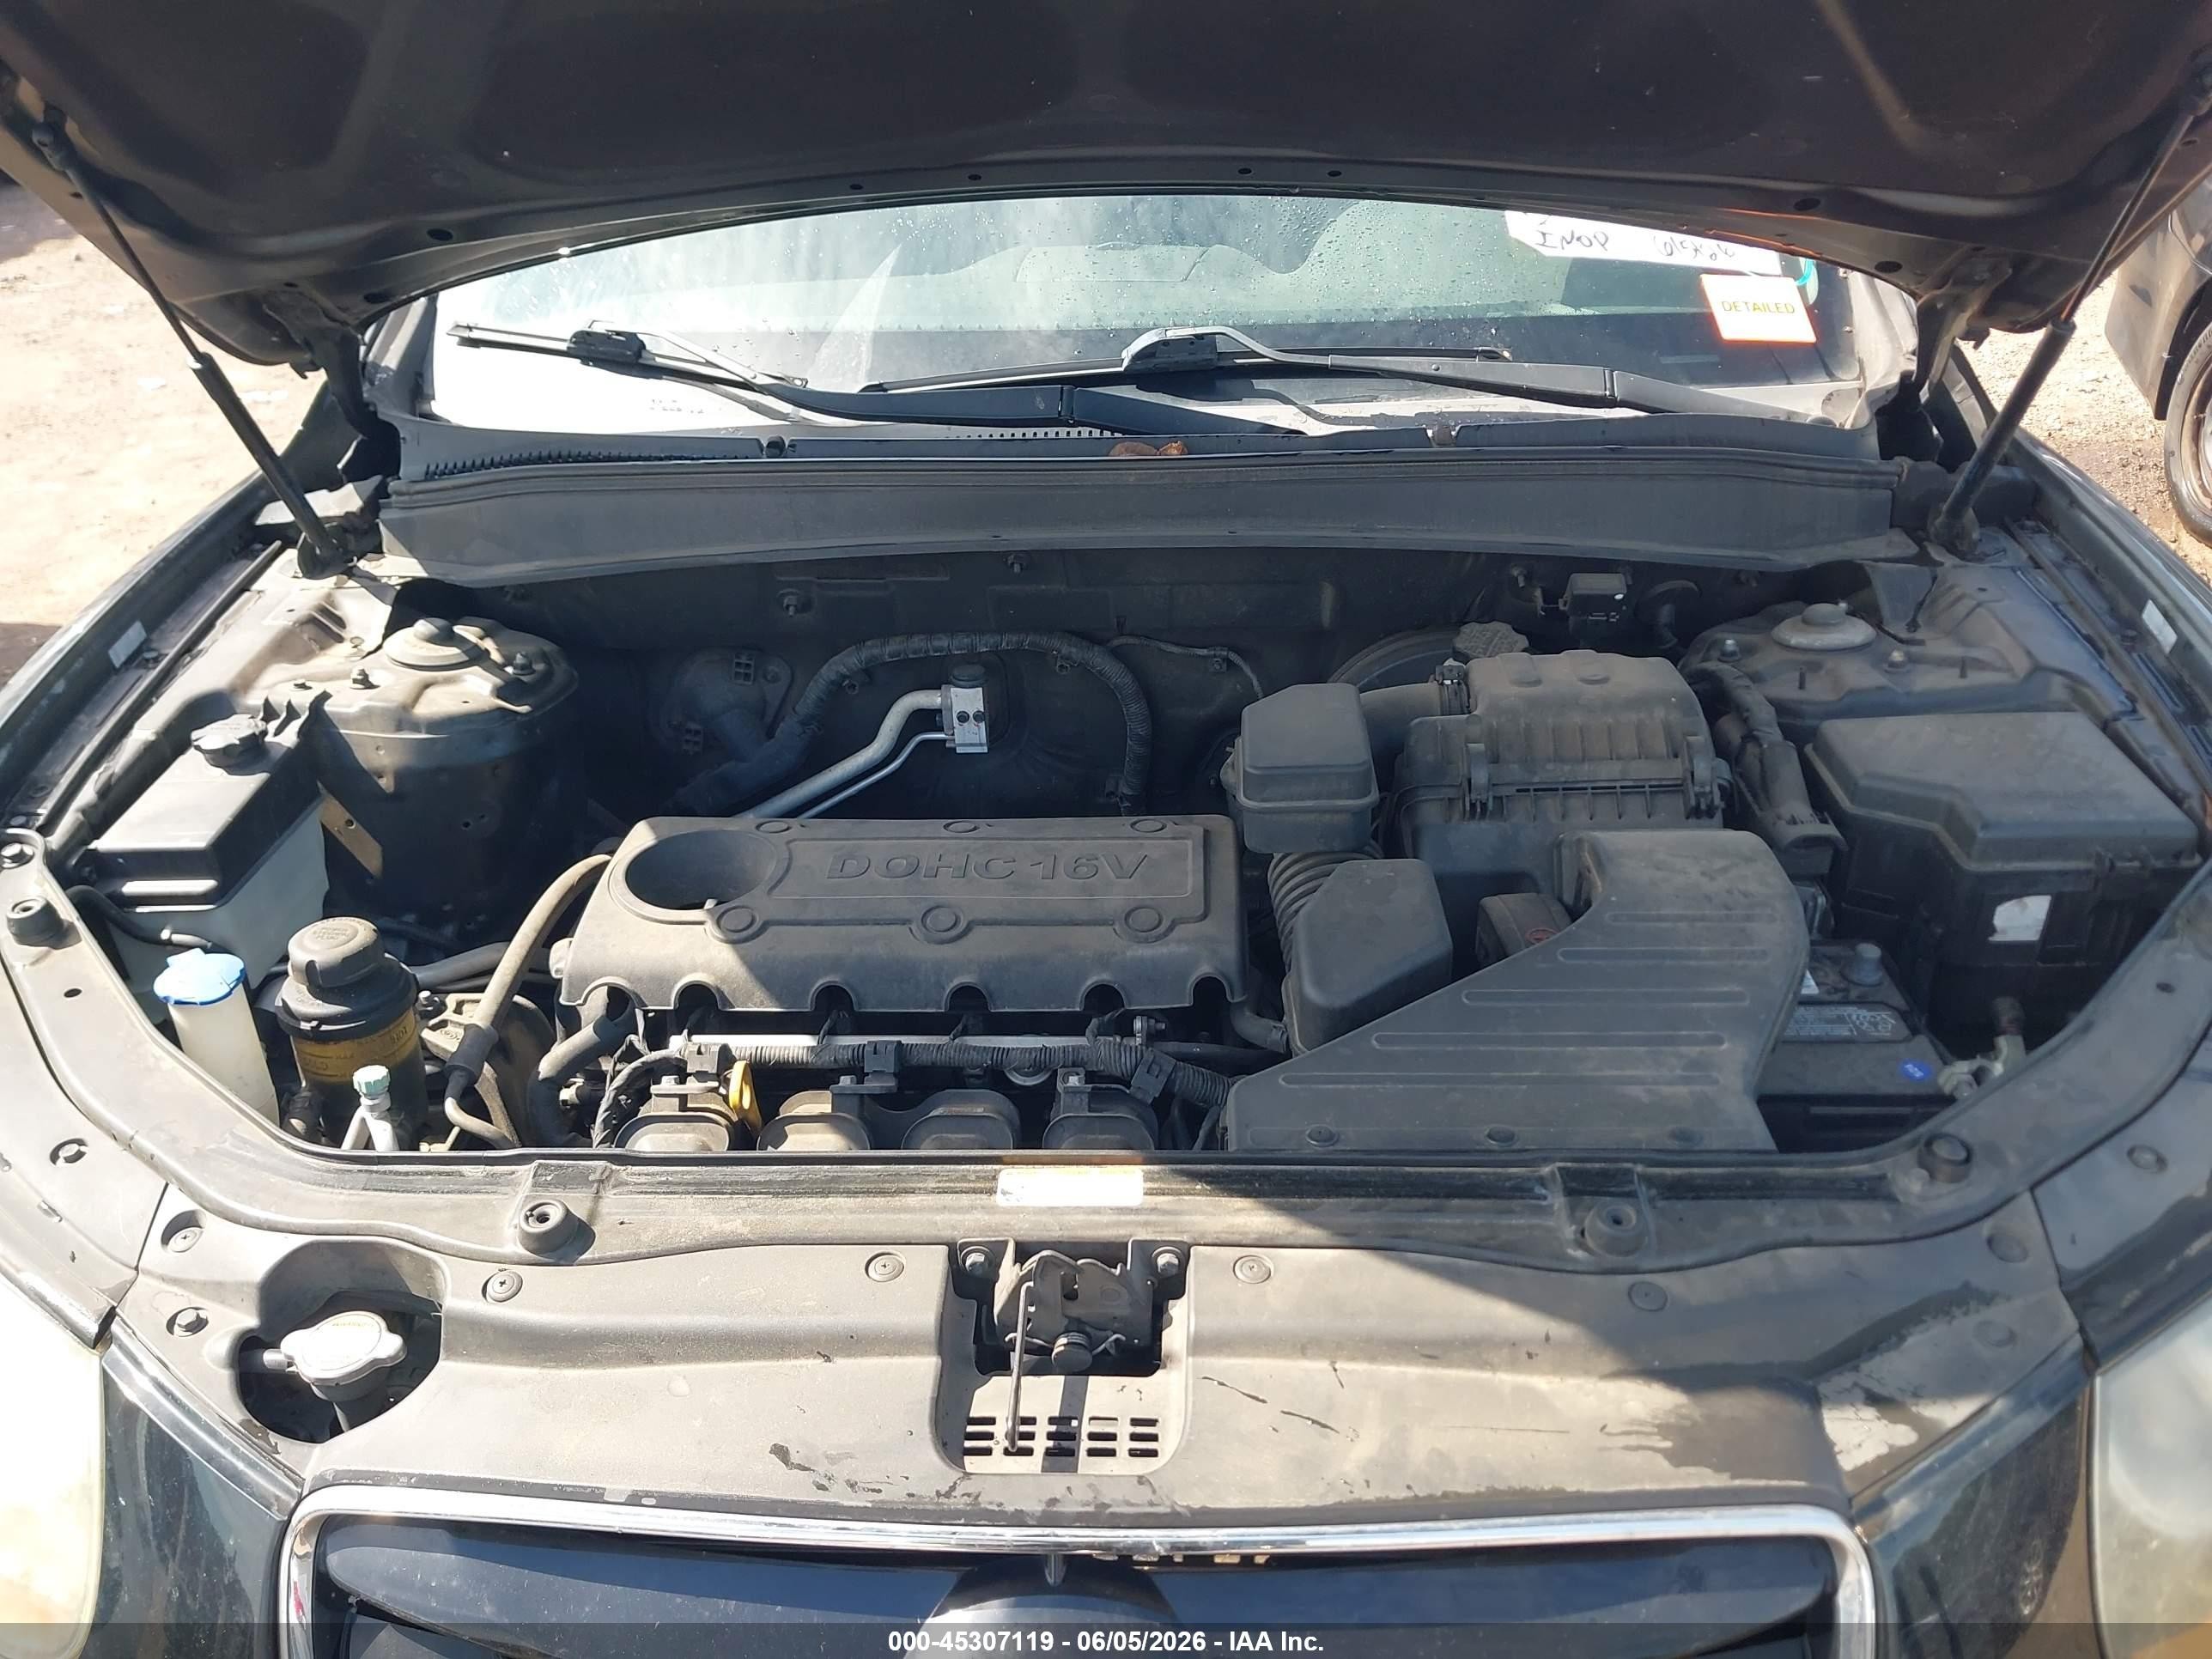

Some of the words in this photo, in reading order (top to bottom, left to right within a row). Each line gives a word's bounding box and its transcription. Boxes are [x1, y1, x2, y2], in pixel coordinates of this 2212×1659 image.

[1535, 229, 1609, 252] INOP
[1721, 301, 1796, 314] DETAILED
[825, 853, 1017, 880] DOHC
[1030, 853, 1148, 880] 16V
